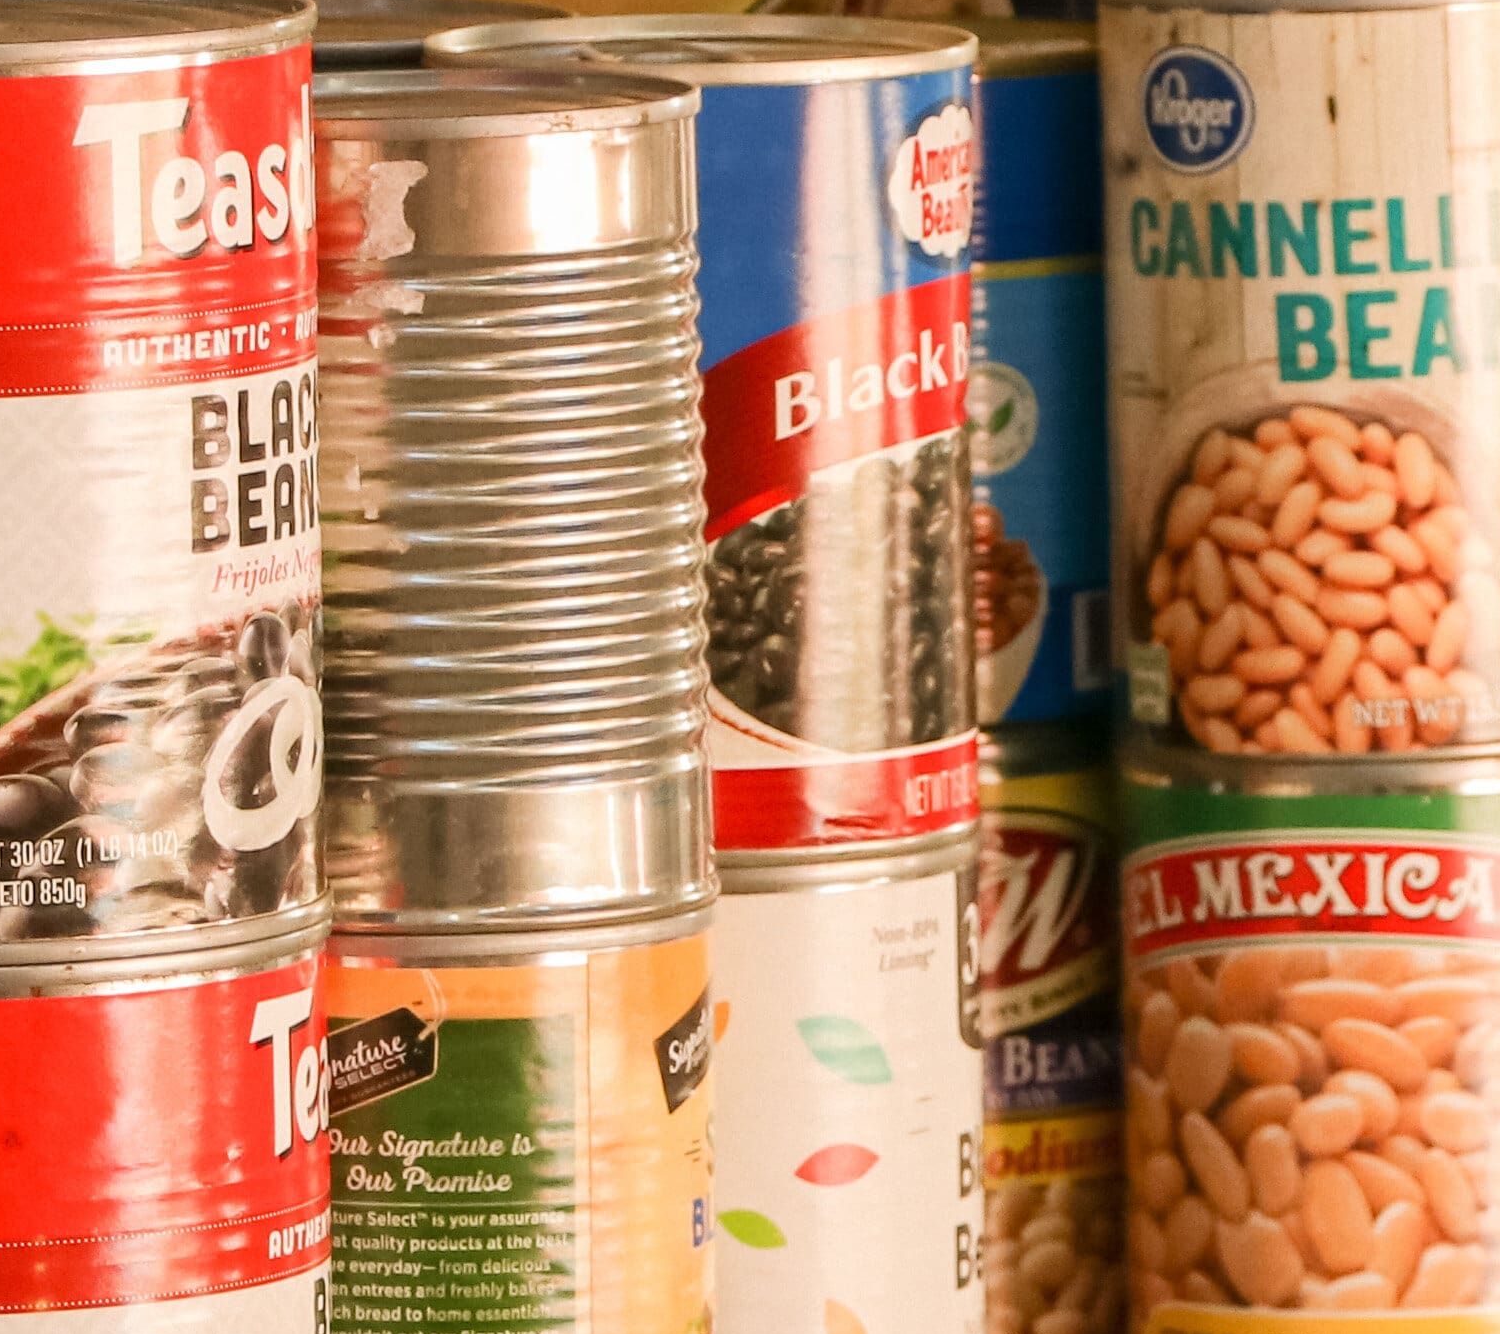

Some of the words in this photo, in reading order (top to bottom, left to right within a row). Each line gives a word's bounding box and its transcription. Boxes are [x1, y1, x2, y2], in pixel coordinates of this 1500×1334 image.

[1149, 68, 1237, 153] Kroger
[104, 321, 271, 368] AUTHENTIC
[775, 329, 948, 441] Black
[192, 371, 318, 471] BLAC
[192, 458, 321, 553] BEAN
[212, 555, 288, 597] Frijoles
[10, 841, 33, 867] 30
[39, 839, 65, 864] OZ
[76, 838, 93, 868] (1
[99, 838, 121, 862] LB
[39, 877, 87, 908] 850g
[1127, 866, 1185, 939] EL
[331, 1035, 406, 1074] nature
[334, 1052, 406, 1091] SELECT
[329, 1129, 371, 1156] Our
[378, 1130, 505, 1166] Signature
[511, 1133, 535, 1156] is
[347, 1165, 396, 1192] Our
[402, 1166, 512, 1193] Promise
[446, 1214, 484, 1229] your
[352, 1235, 405, 1253] quality
[410, 1236, 482, 1252] products
